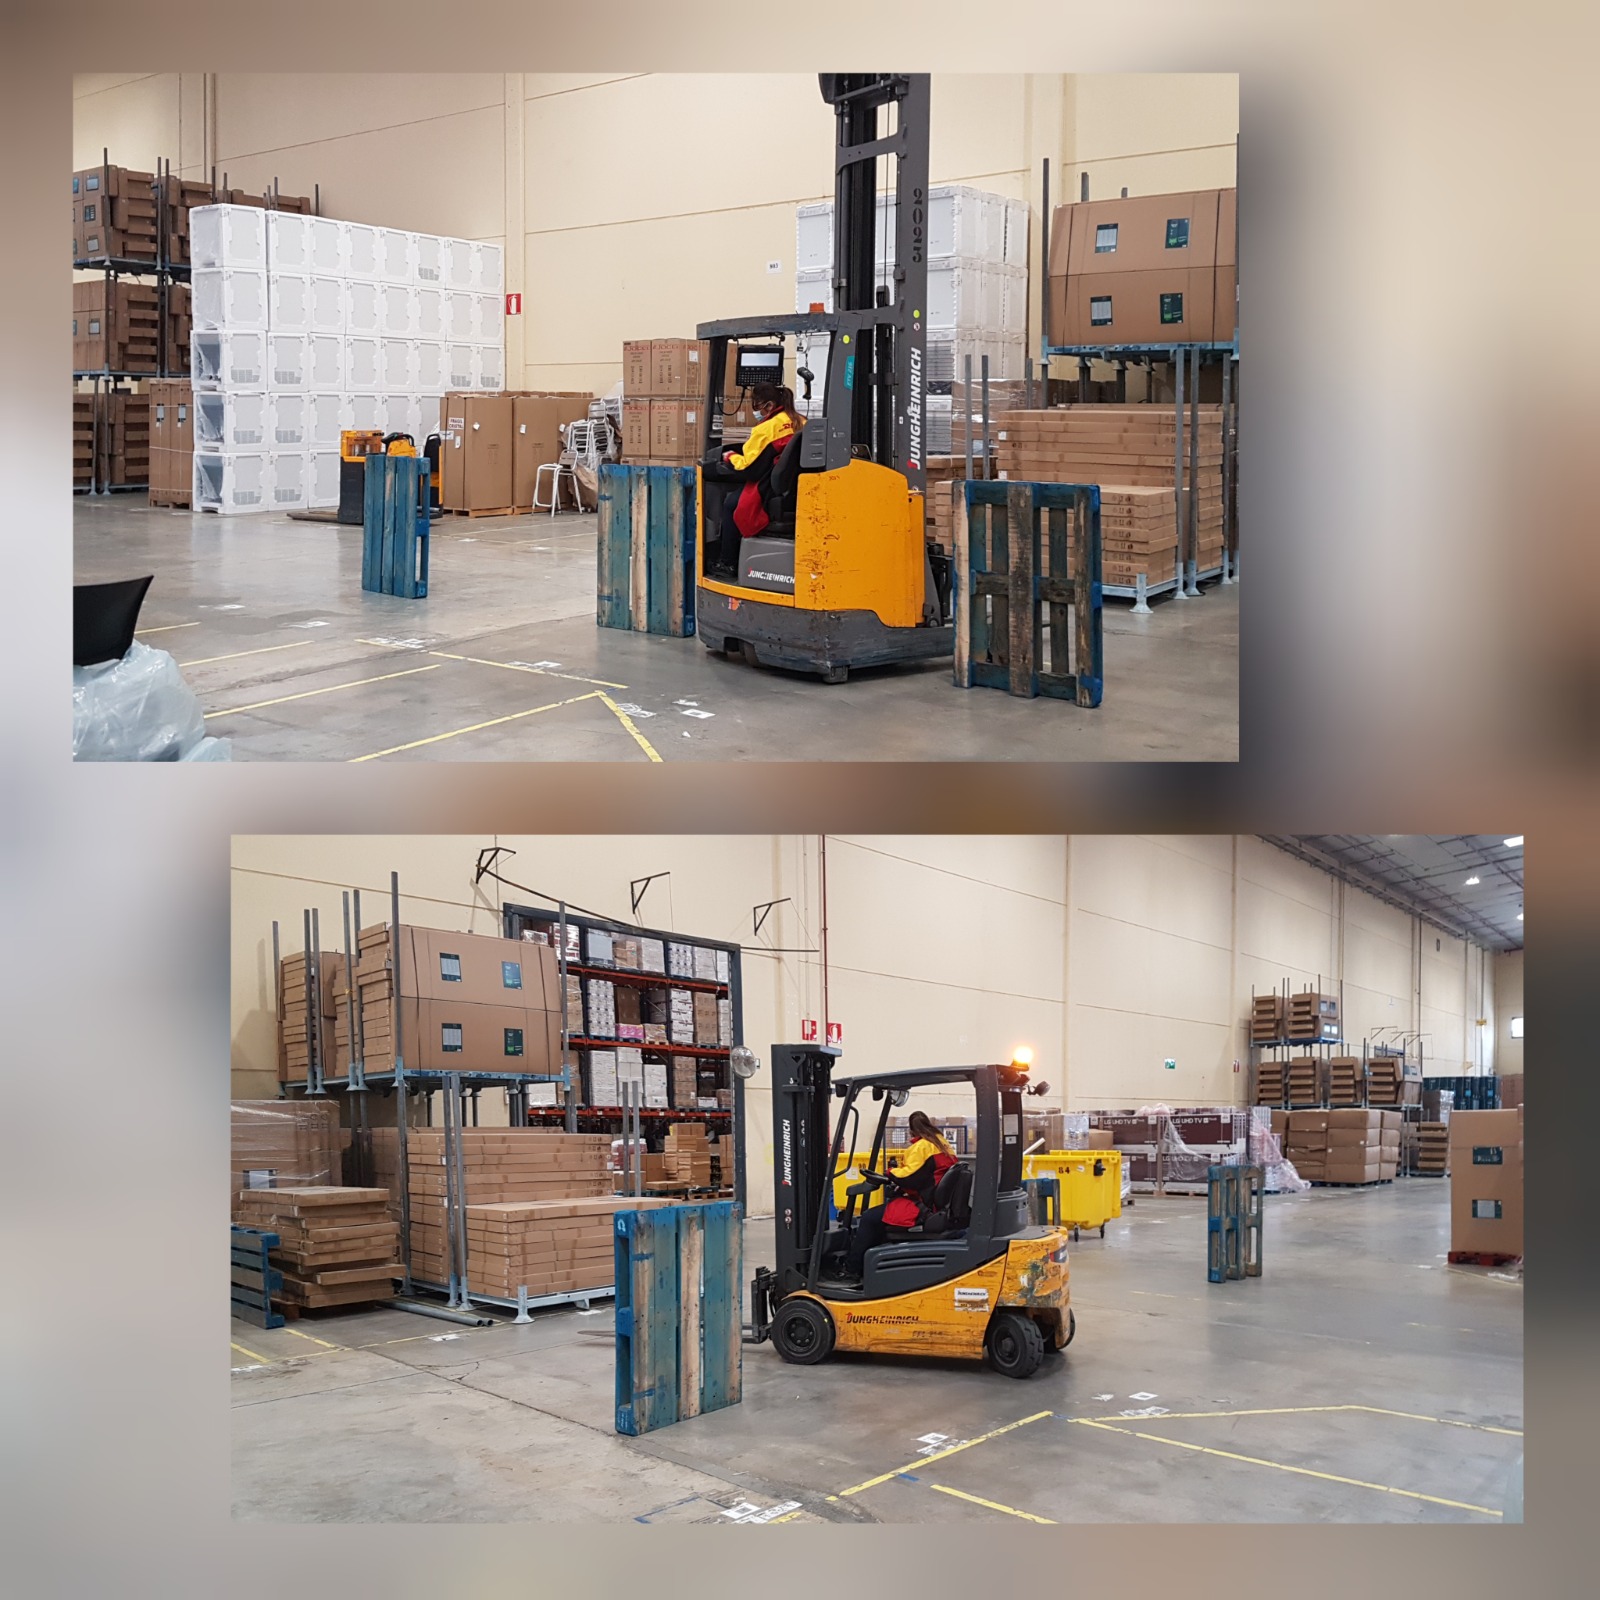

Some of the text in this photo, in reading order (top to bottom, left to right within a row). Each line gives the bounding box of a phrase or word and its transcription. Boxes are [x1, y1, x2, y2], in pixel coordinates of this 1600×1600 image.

[912, 188, 923, 263] 2023
[907, 347, 922, 470] JUNGHEINRICH
[782, 1119, 792, 1186] JUNGHEINRICH
[1058, 1166, 1070, 1174] 84
[845, 1312, 919, 1324] JUNGHEINRICH
